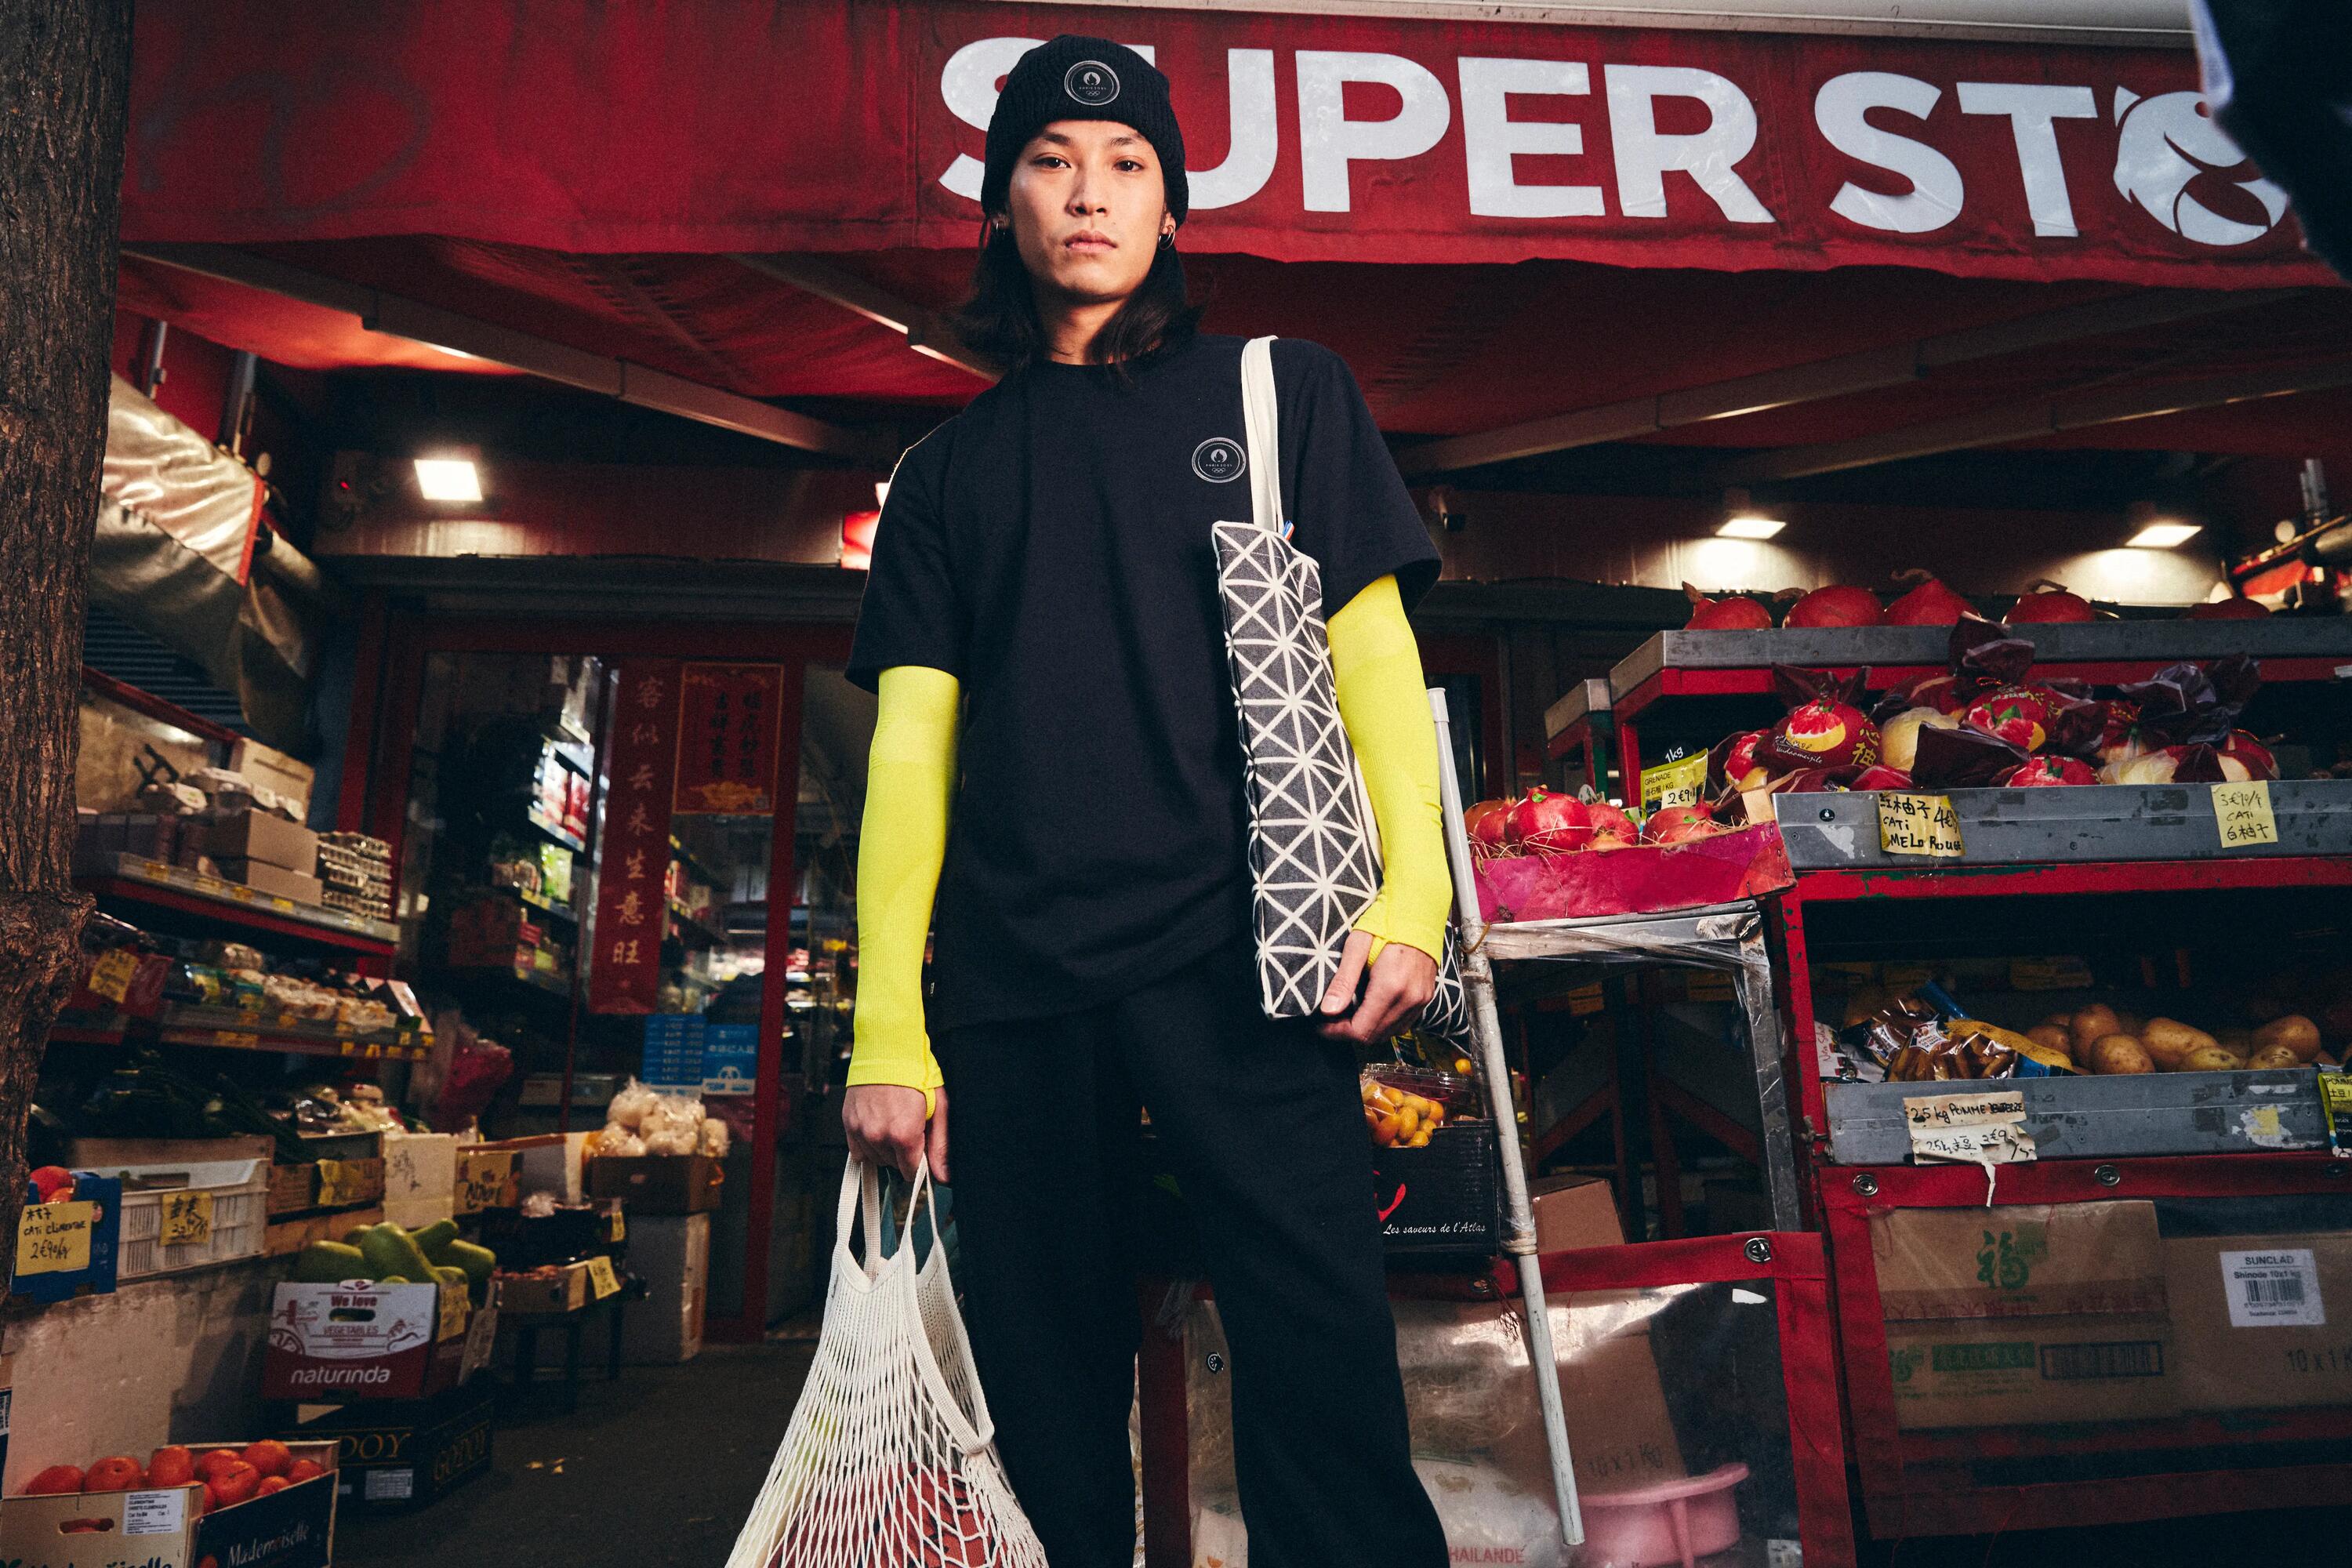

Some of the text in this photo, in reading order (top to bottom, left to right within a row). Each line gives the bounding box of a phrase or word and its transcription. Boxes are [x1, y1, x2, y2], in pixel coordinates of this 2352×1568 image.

[1665, 746, 1684, 763] 1kg
[1644, 771, 1671, 785] GRENADE
[2329, 1088, 2347, 1098] 土豆
[1949, 1102, 1986, 1116] POMME
[1383, 1223, 1400, 1236] Les
[1403, 1225, 1436, 1234] saveurs
[1440, 1223, 1450, 1234] de
[1976, 1229, 2029, 1290] 福
[2245, 1256, 2295, 1265] SUNCLAD
[331, 1295, 378, 1307] We love
[324, 1325, 379, 1335] VEGETABLES
[290, 1366, 391, 1384] naturinda
[1448, 1545, 1525, 1563] HAILANDE
